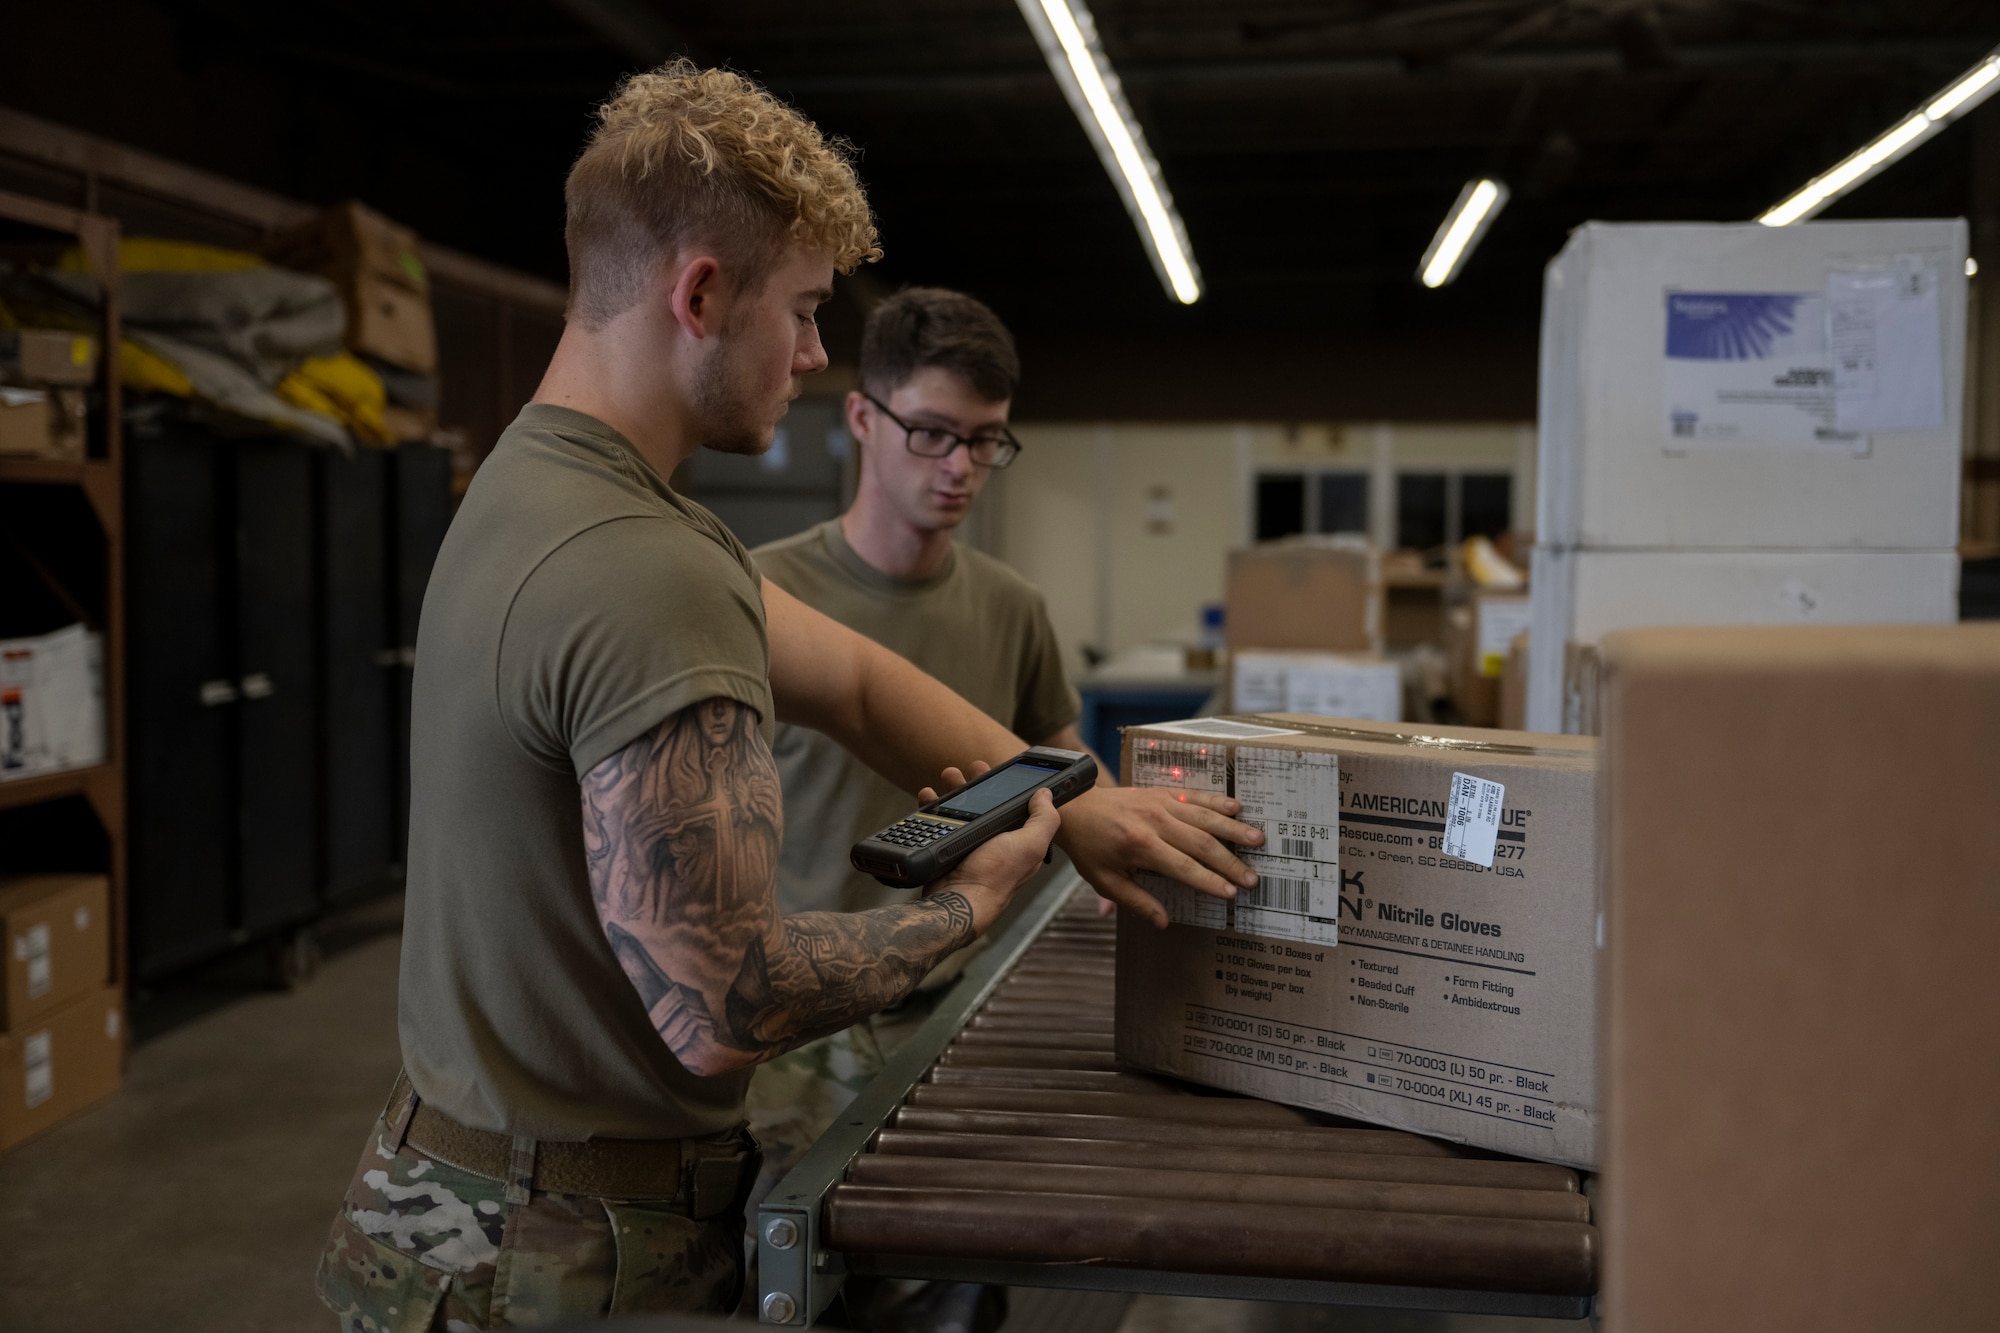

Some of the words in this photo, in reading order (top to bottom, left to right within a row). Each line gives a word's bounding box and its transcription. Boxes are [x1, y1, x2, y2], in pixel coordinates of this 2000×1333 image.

[1339, 769, 1353, 784] by:
[1461, 778, 1471, 797] DAN
[1351, 792, 1445, 818] AMERICAN
[1457, 806, 1467, 826] 1006
[1278, 823, 1288, 836] GA
[1292, 824, 1306, 838] 316
[1310, 826, 1329, 840] 0-01
[1348, 846, 1366, 858] Ct.
[1418, 855, 1436, 867] SC
[1496, 865, 1525, 879] USA
[1378, 902, 1435, 928] Nitrile
[1440, 912, 1502, 938] Gloves
[1216, 935, 1267, 953] CONTENTS:
[1270, 945, 1283, 955] 10
[1285, 947, 1312, 960] Boxes
[1315, 952, 1324, 962] of
[1356, 928, 1420, 946] MANAGEMENT
[1421, 938, 1429, 948] &
[1430, 939, 1474, 955] DETAINEE
[1475, 947, 1525, 963] HANDLING
[1227, 954, 1245, 966] 100
[1247, 958, 1276, 971] Gloves
[1278, 965, 1293, 975] per
[1295, 966, 1311, 978] box
[1358, 959, 1399, 975] Textured
[1225, 984, 1239, 997] (by
[1240, 988, 1272, 1003] weight)
[1226, 971, 1238, 981] 90
[1240, 974, 1269, 987] Gloves
[1271, 981, 1286, 991] per
[1289, 982, 1304, 994] box
[1358, 977, 1392, 992] Beaded
[1395, 983, 1415, 996] Cuff
[1453, 975, 1479, 989] Form
[1482, 980, 1514, 998] Fitting
[1357, 995, 1409, 1014] Non-Sterile
[1451, 993, 1521, 1015] Ambidextrous
[1211, 1015, 1253, 1033] 70-0001
[1258, 1024, 1272, 1038] (S)
[1275, 1028, 1290, 1040] 50
[1293, 1034, 1307, 1044] pr.
[1317, 1036, 1346, 1052] Black
[1209, 1039, 1254, 1058] 70-0002
[1257, 1049, 1275, 1064] (M)
[1278, 1054, 1293, 1066] 50
[1295, 1060, 1309, 1071] pr.
[1320, 1062, 1348, 1079] Black
[1396, 1051, 1446, 1072] 70-0003
[1450, 1063, 1465, 1077] (L)
[1469, 1066, 1485, 1080] 50
[1489, 1073, 1504, 1084] pr.
[1516, 1075, 1549, 1093] Black
[1396, 1077, 1446, 1099] 70-0004
[1450, 1089, 1472, 1106] (XL)
[1476, 1096, 1492, 1108] 45
[1496, 1102, 1511, 1113] pr.
[1523, 1105, 1556, 1122] Black
